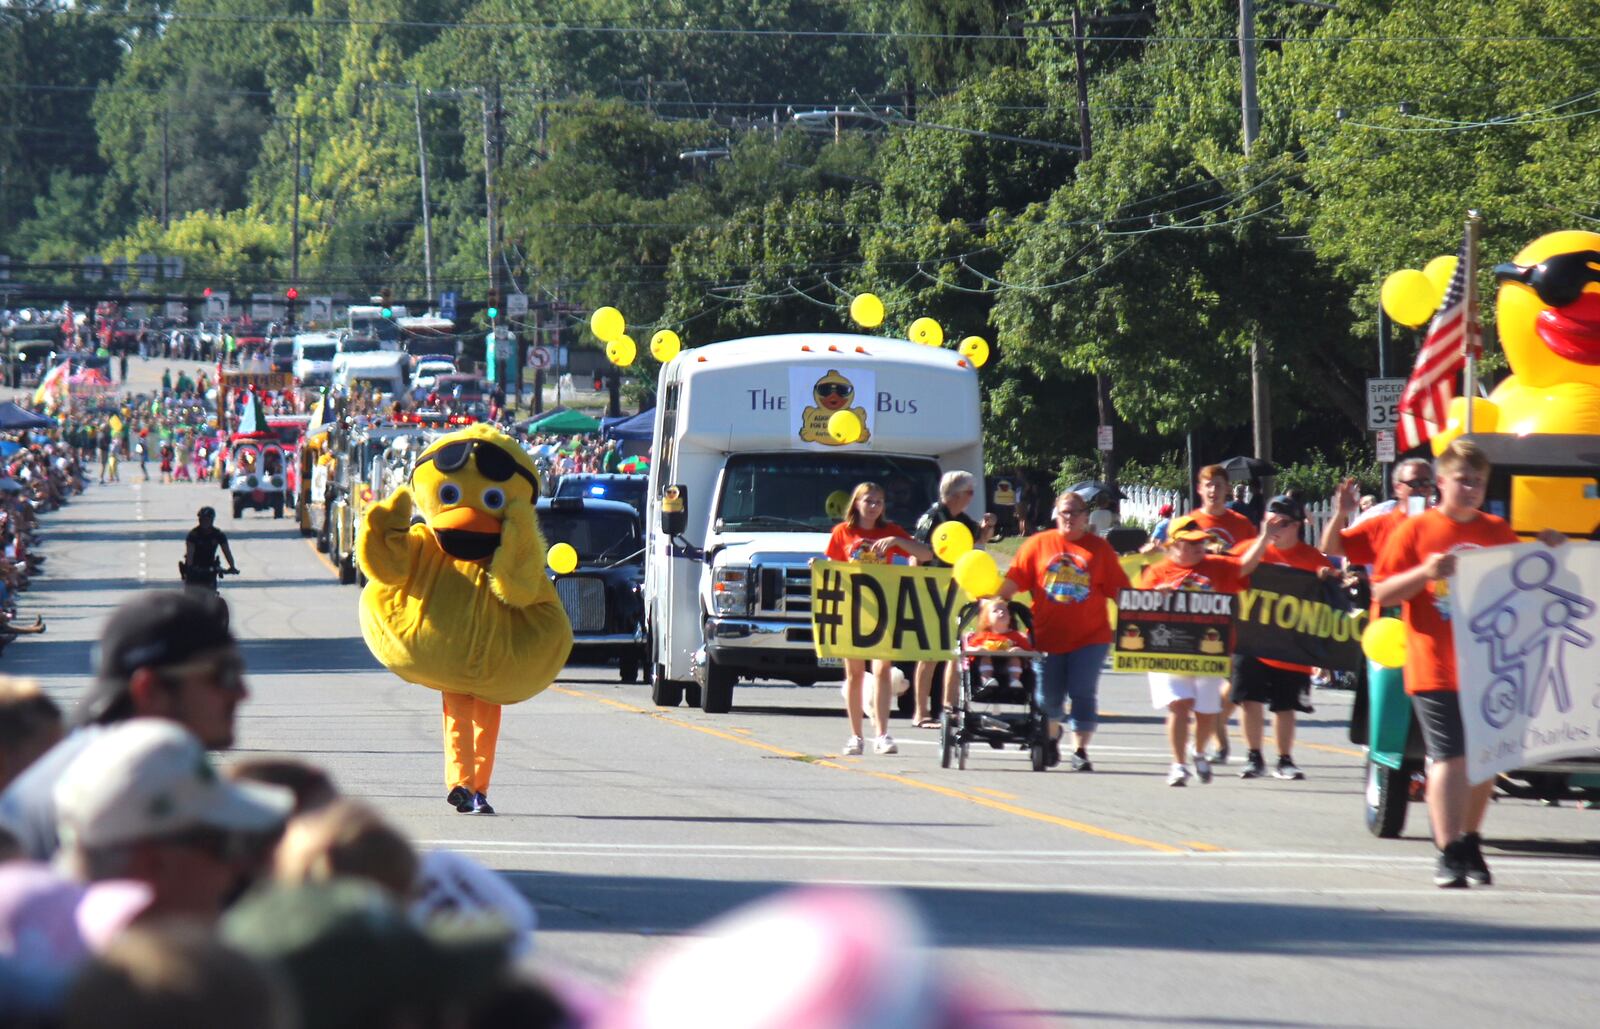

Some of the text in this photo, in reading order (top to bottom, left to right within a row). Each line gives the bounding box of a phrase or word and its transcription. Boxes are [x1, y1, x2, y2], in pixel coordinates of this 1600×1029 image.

[441, 293, 455, 307] H
[1371, 385, 1404, 393] SPEED
[1375, 395, 1400, 403] LIMIT
[1373, 406, 1402, 424] 35
[815, 569, 959, 650] #DAY
[1120, 590, 1232, 615] ADOPT A DUCK
